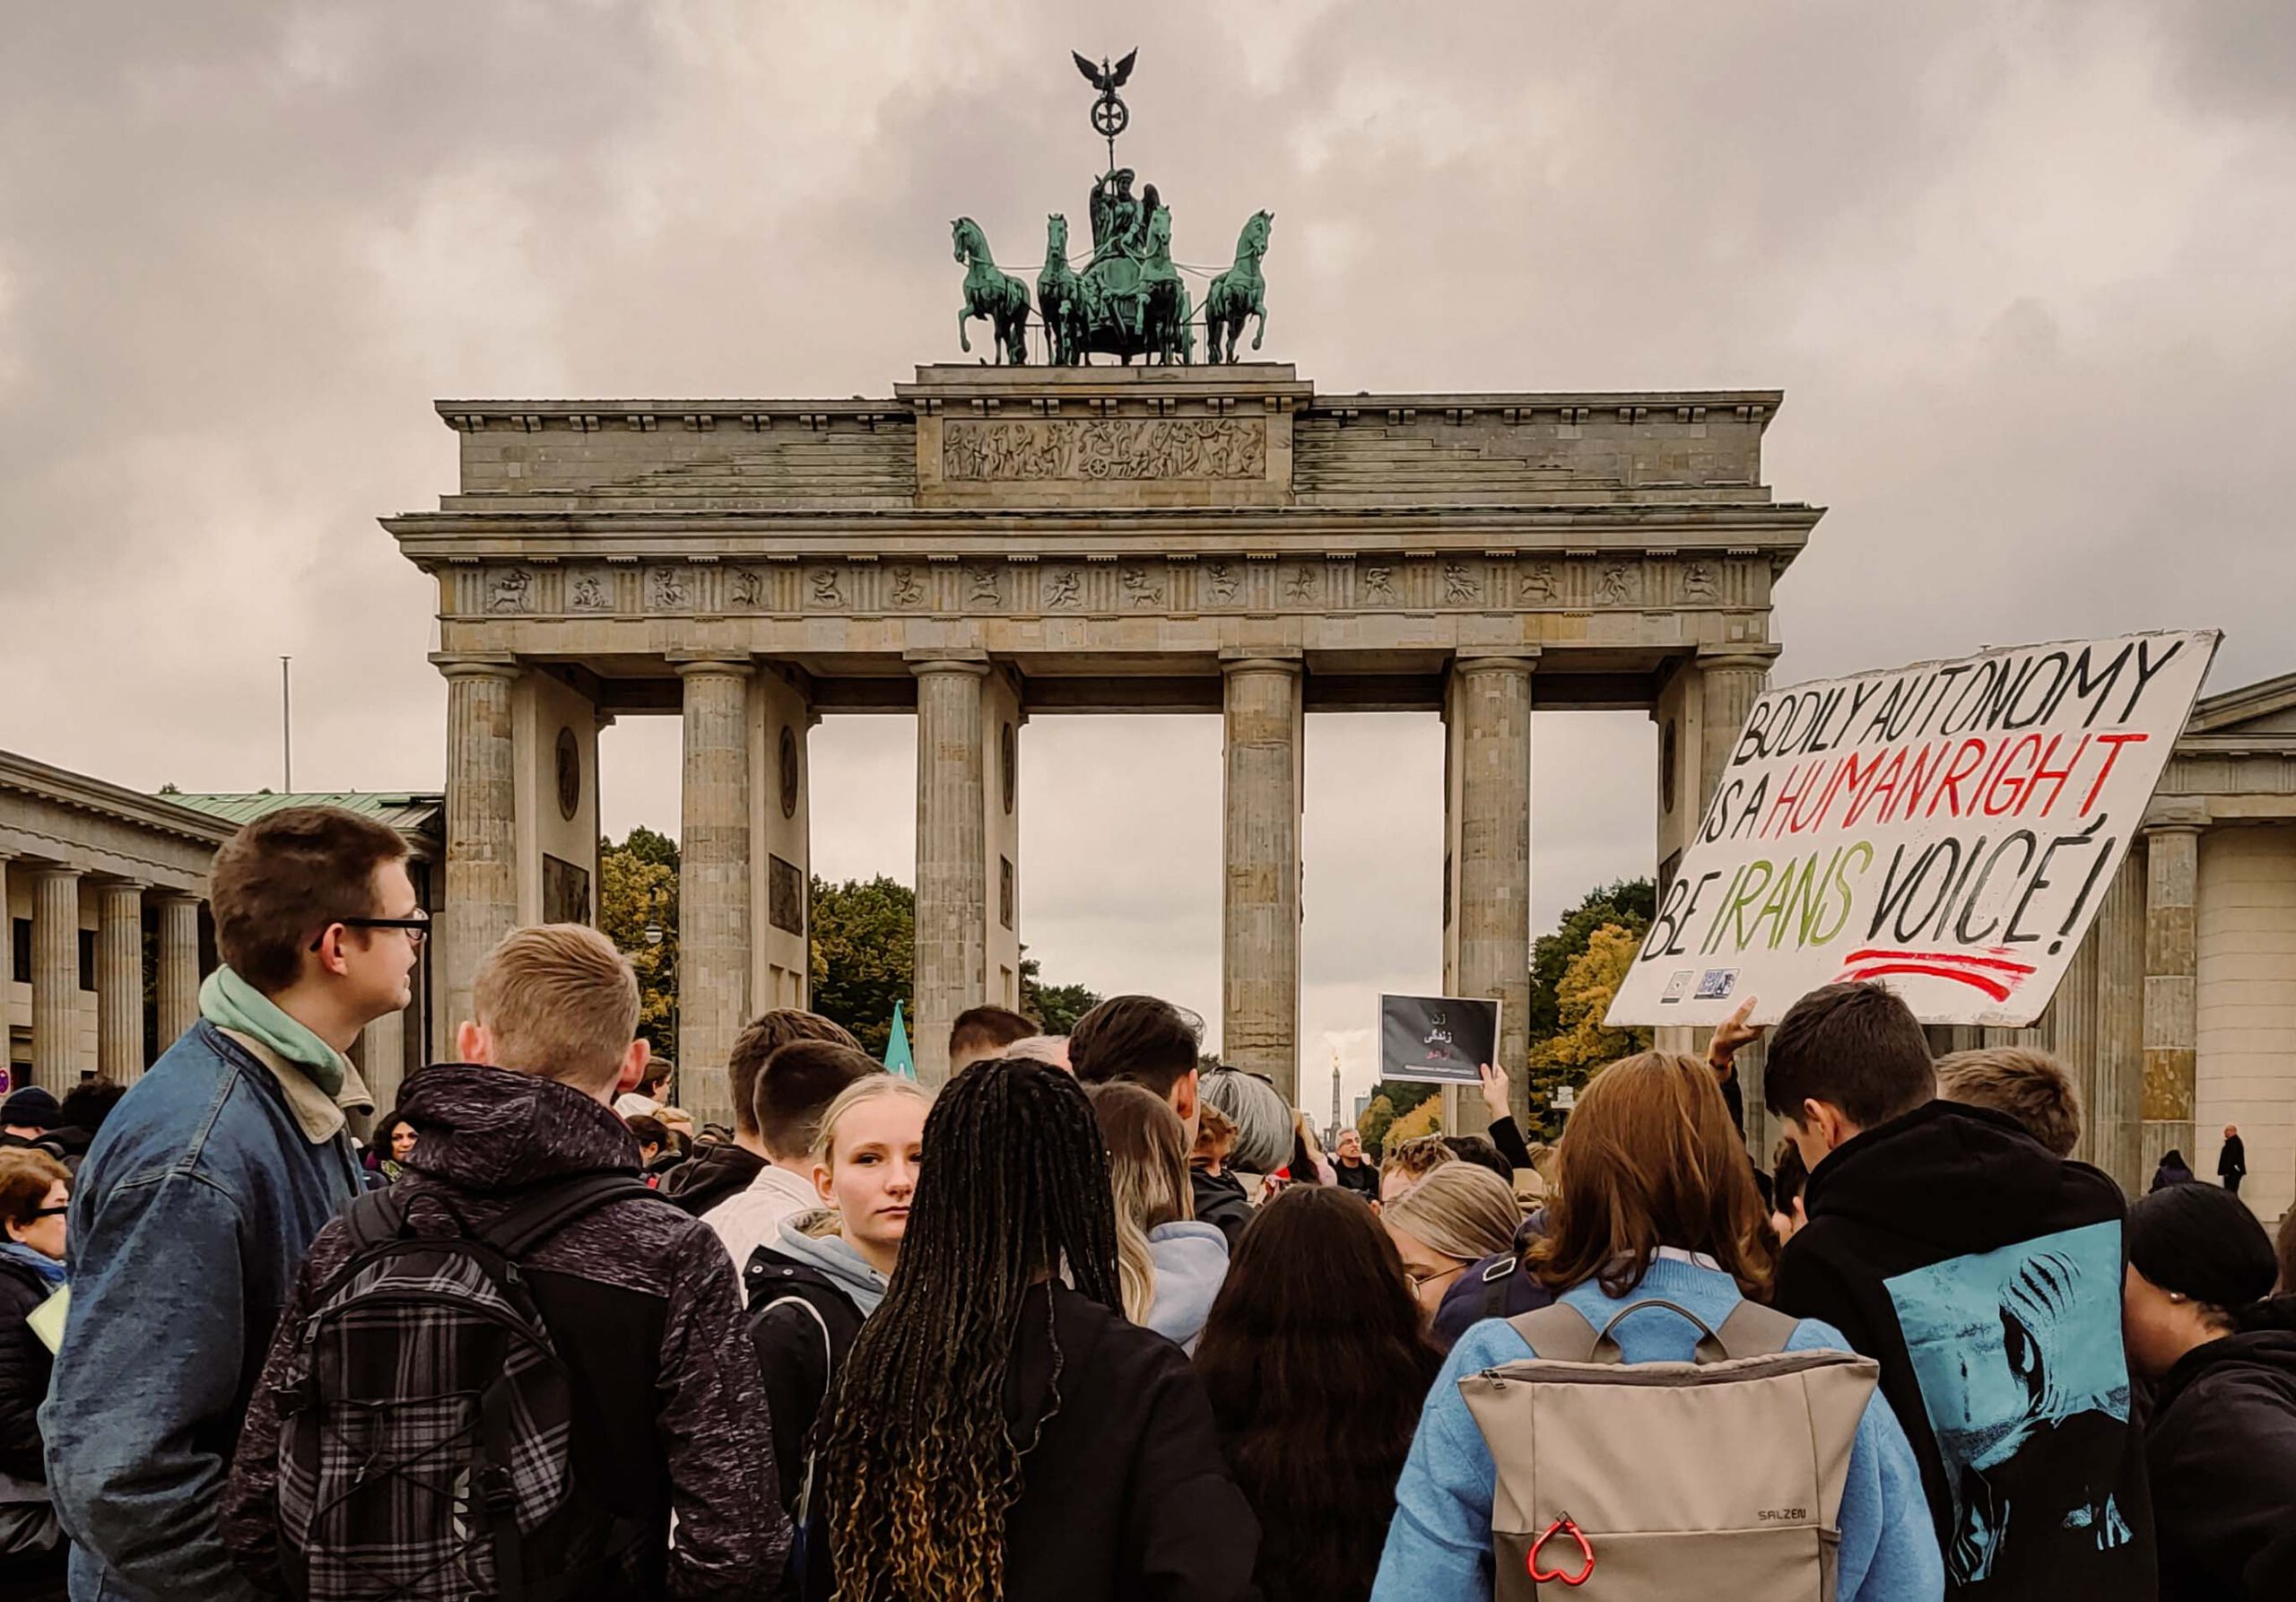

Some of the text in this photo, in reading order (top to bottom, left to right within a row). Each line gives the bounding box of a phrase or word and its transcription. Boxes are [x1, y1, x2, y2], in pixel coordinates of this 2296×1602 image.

[1733, 640, 2185, 766] BODILY AUTONOMY
[1696, 781, 1744, 845] IS
[1730, 772, 1770, 840] A
[1759, 740, 1952, 840] HUMAN
[1640, 829, 2117, 962] BE IRANS VOICE!
[1758, 1509, 1806, 1520] SALZEN
